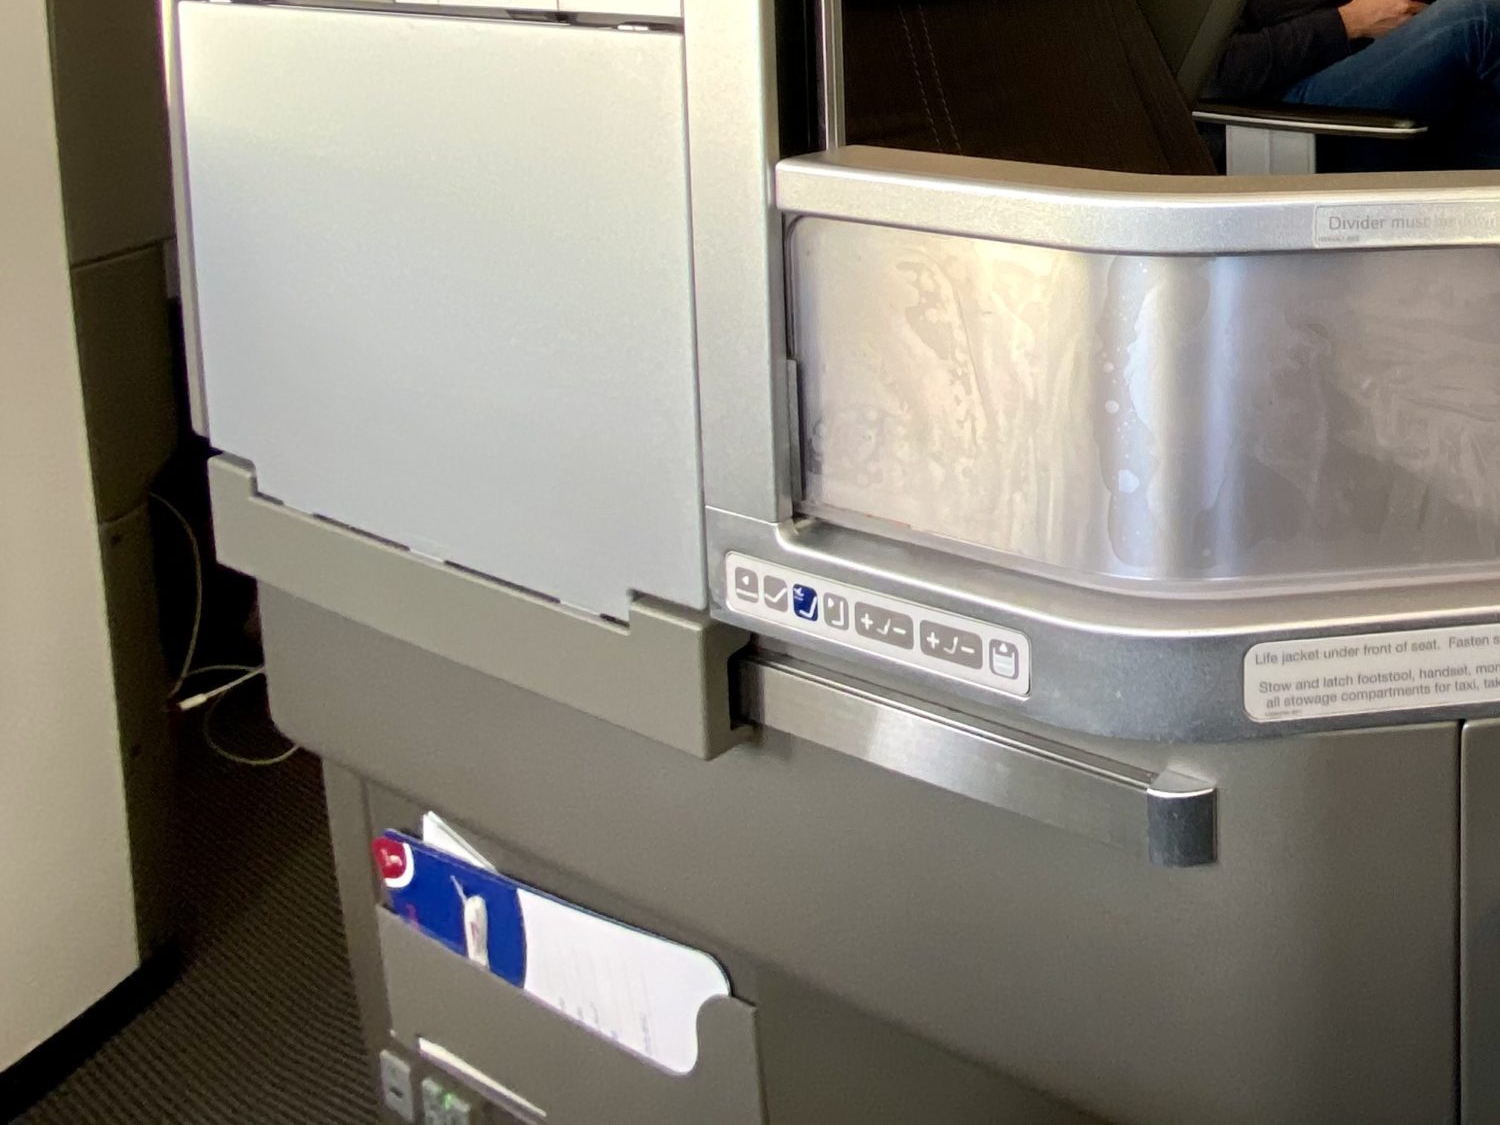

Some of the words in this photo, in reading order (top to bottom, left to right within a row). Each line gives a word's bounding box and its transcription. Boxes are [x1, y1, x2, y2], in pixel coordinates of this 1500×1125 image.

[1328, 214, 1385, 230] Divider
[1255, 652, 1278, 665] Life
[1281, 649, 1320, 665] jacket
[1323, 646, 1359, 660] under
[1363, 642, 1392, 656] front
[1395, 641, 1408, 653] of
[1411, 638, 1440, 652] seat.
[1448, 635, 1489, 648] Fasten
[1259, 681, 1292, 694] Stow
[1295, 677, 1319, 690] and
[1323, 675, 1354, 688] latch
[1358, 669, 1415, 684] footstool,
[1420, 665, 1472, 679] handset,
[1266, 696, 1280, 709] all
[1284, 692, 1337, 707] stowage
[1341, 684, 1430, 702] compartments
[1434, 681, 1451, 693] for
[1454, 678, 1480, 691] taxi,
